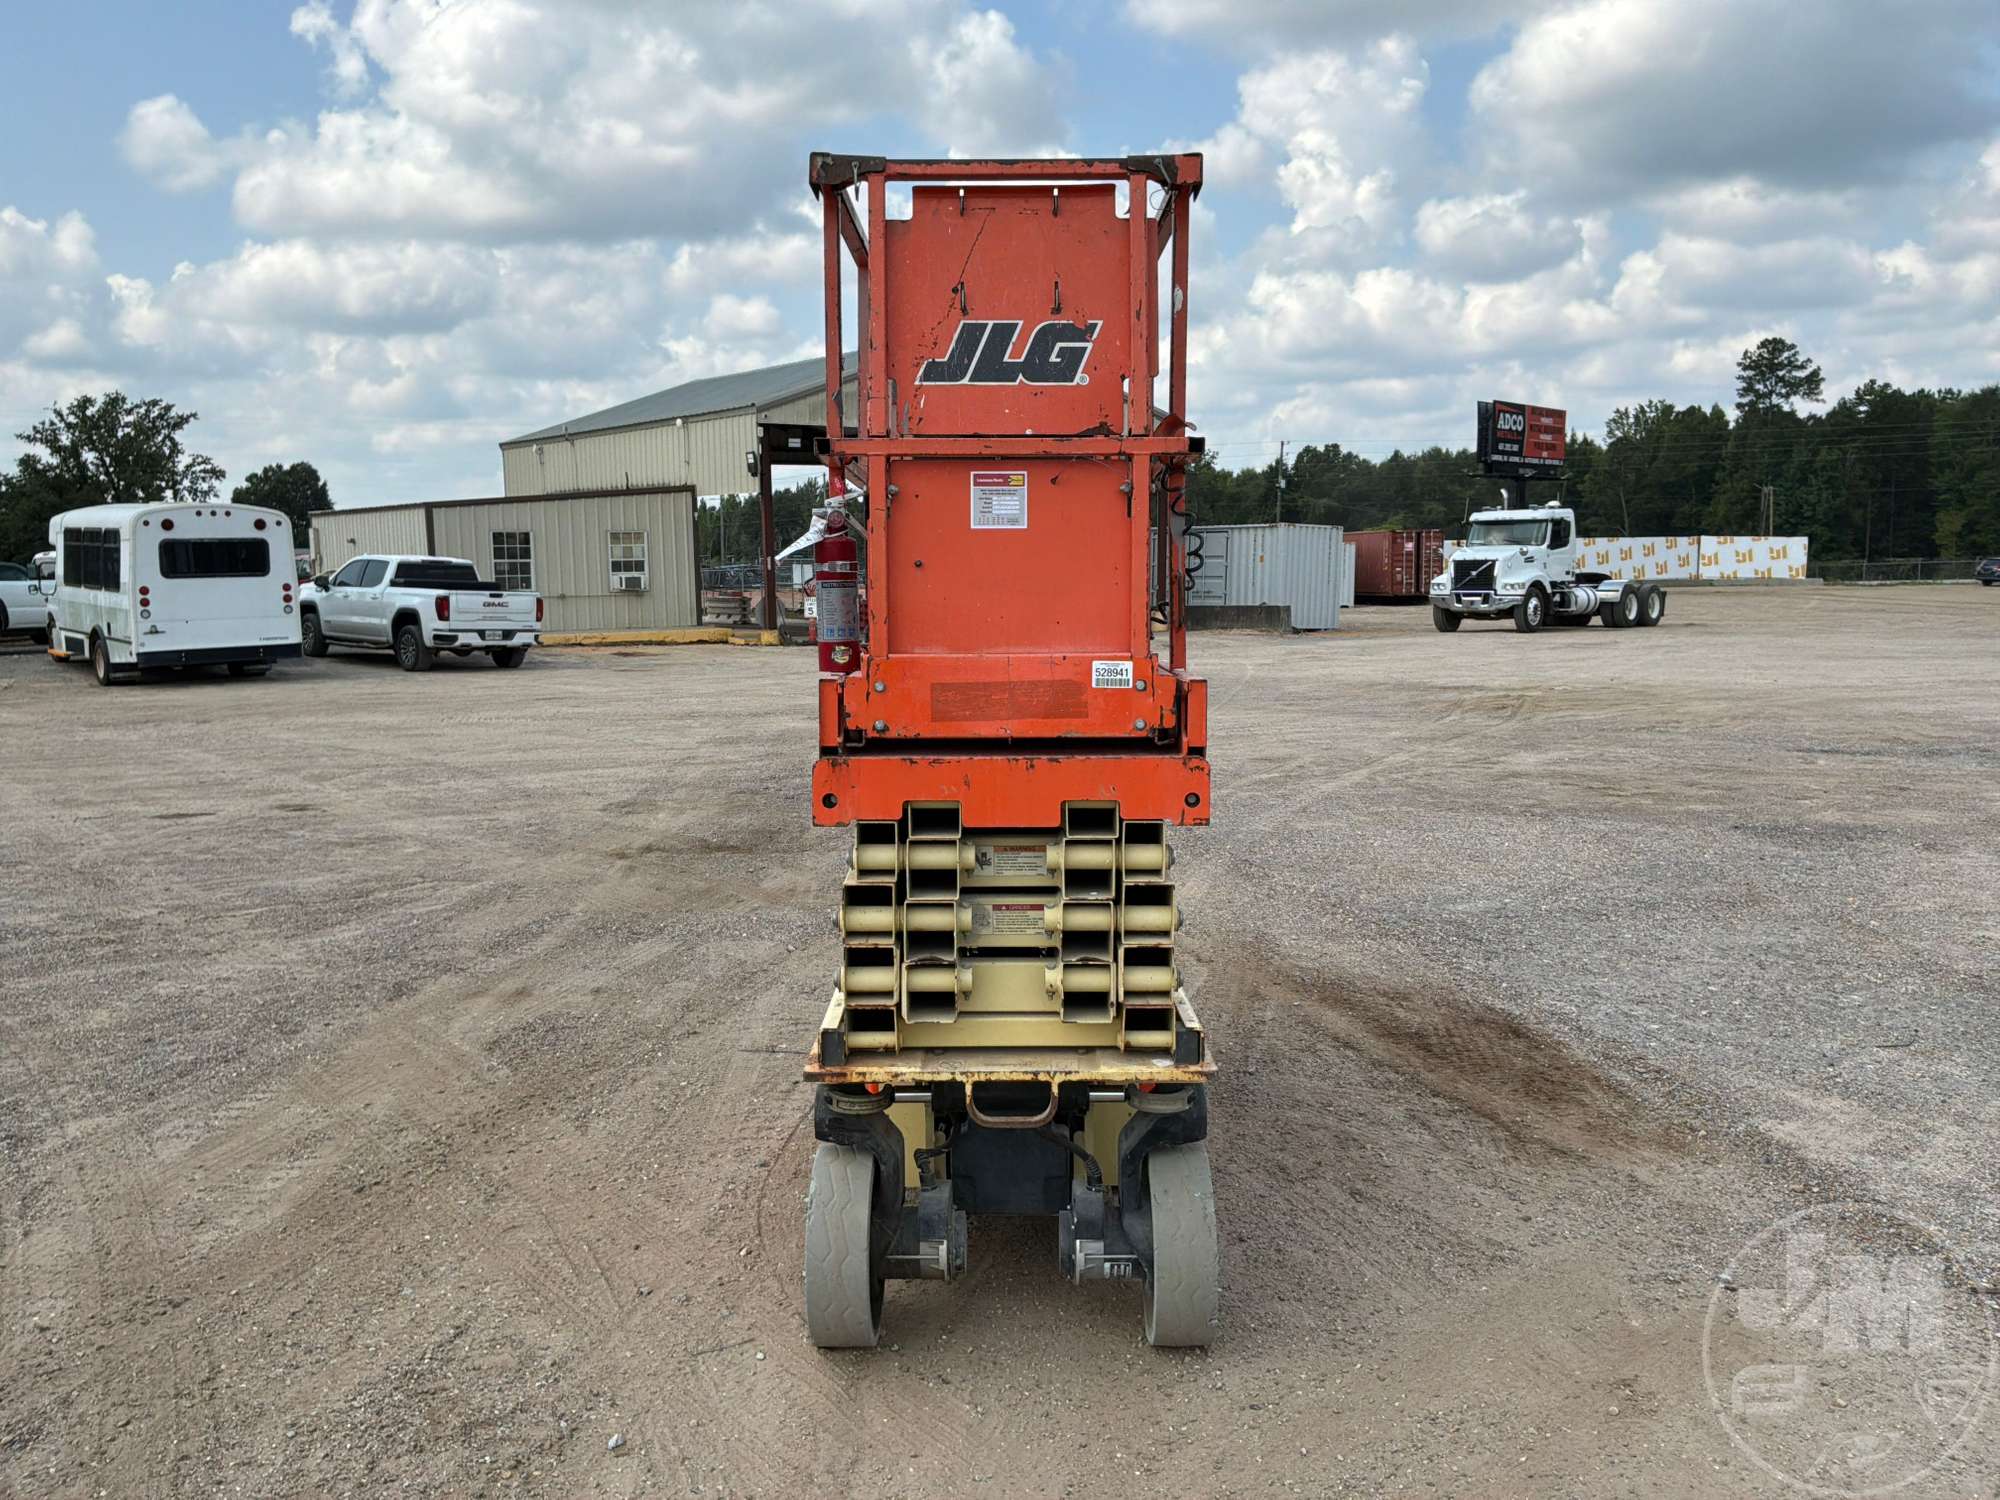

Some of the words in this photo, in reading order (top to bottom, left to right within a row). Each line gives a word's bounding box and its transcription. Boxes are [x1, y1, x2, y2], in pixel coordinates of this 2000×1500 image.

[913, 319, 1104, 386] JLG
[1497, 412, 1523, 431] ADCO
[808, 607, 814, 615] 5
[1095, 668, 1129, 677] 528941
